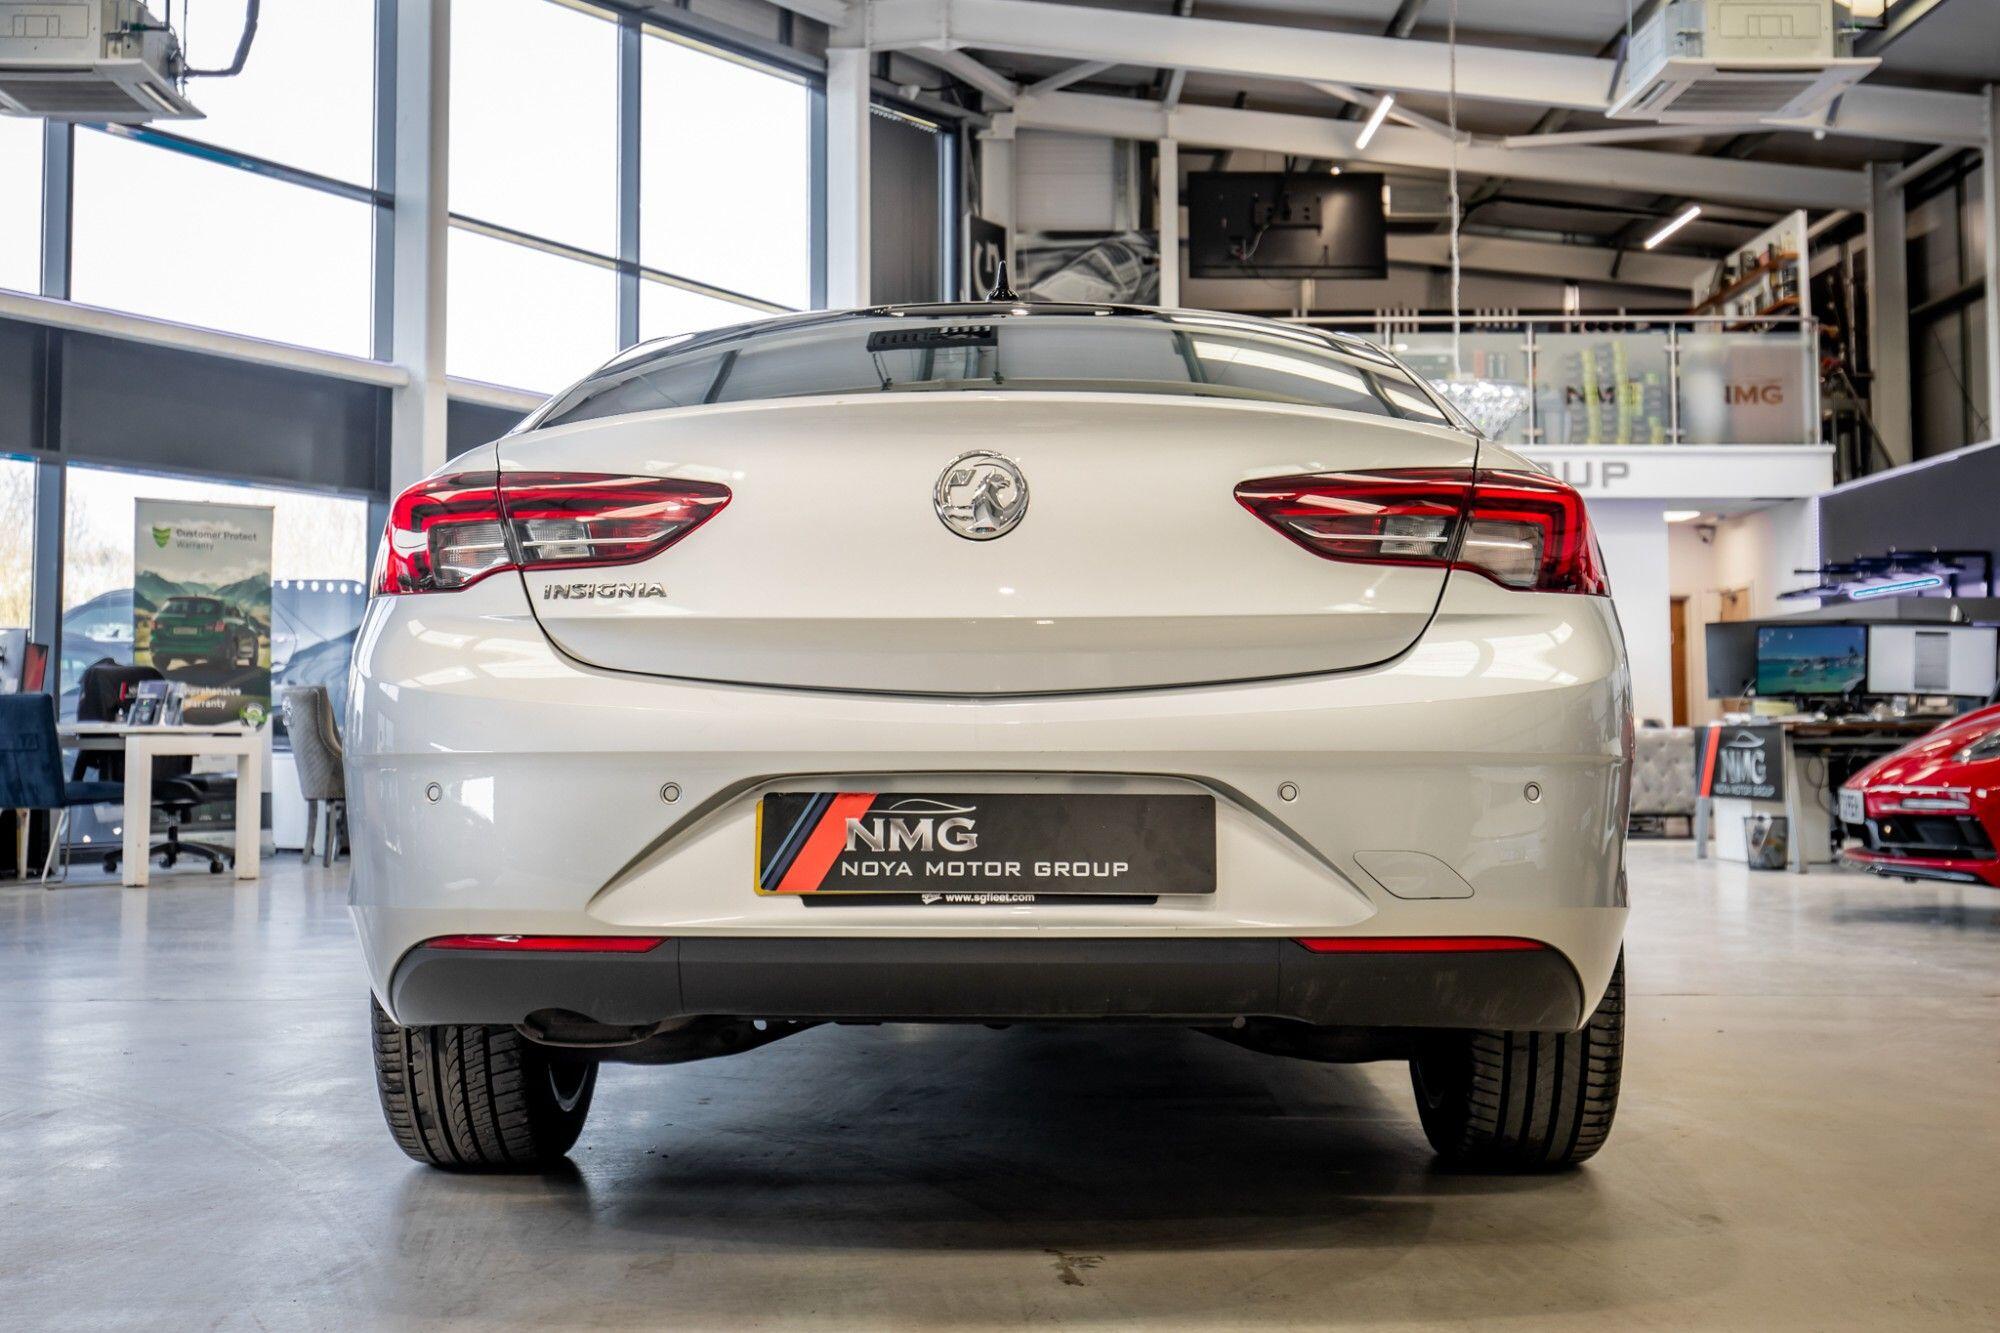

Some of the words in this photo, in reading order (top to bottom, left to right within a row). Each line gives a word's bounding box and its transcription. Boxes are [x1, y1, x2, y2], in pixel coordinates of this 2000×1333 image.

[176, 527, 221, 540] Customer
[223, 531, 257, 542] Protect
[176, 540, 215, 551] Warranty
[543, 582, 667, 600] INSIGNIA
[1720, 748, 1767, 785] NMG
[844, 817, 979, 852] NMG
[841, 861, 913, 877] NOYA
[925, 861, 1022, 877] MOTOR
[1033, 861, 1130, 878] GROUP
[945, 892, 1036, 905] www.sgfleet.com
